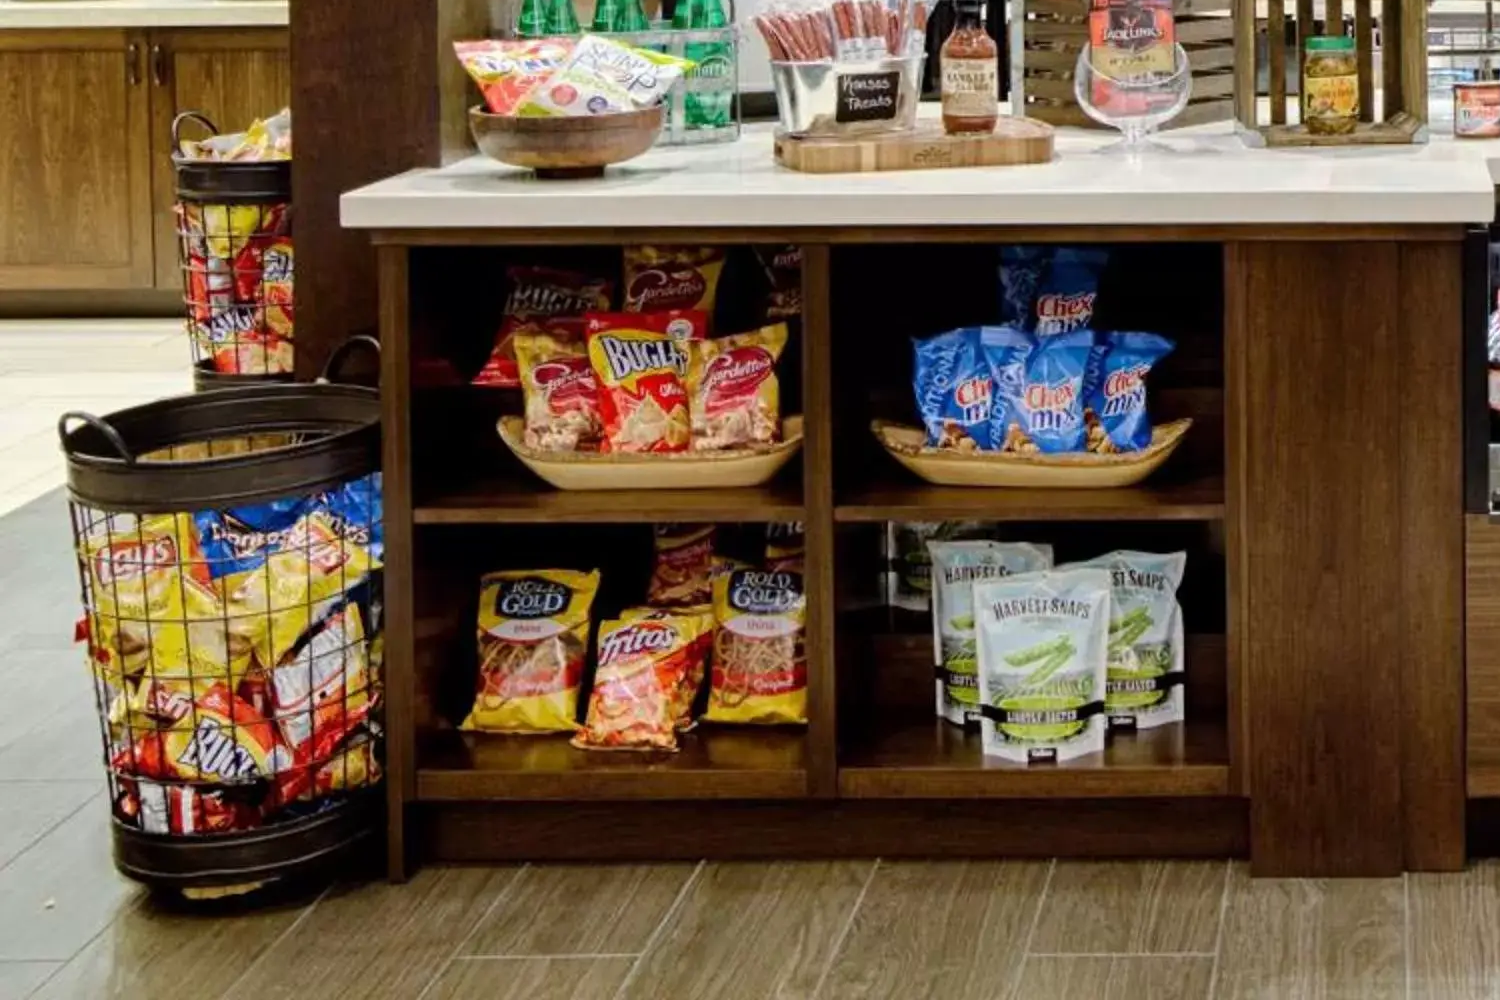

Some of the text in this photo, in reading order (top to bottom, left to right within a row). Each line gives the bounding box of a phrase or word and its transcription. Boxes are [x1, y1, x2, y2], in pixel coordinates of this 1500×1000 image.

[1037, 292, 1097, 318] Chex
[1024, 378, 1075, 411] Chex
[1029, 407, 1076, 432] mix
[97, 539, 176, 584] Lay's
[743, 571, 791, 589] ROLD
[945, 565, 995, 584] HARVEST
[502, 592, 563, 614] GOLD
[733, 587, 796, 608] GOLD
[993, 597, 1091, 621] HARVEST SNAPS
[599, 627, 677, 668] Fritos
